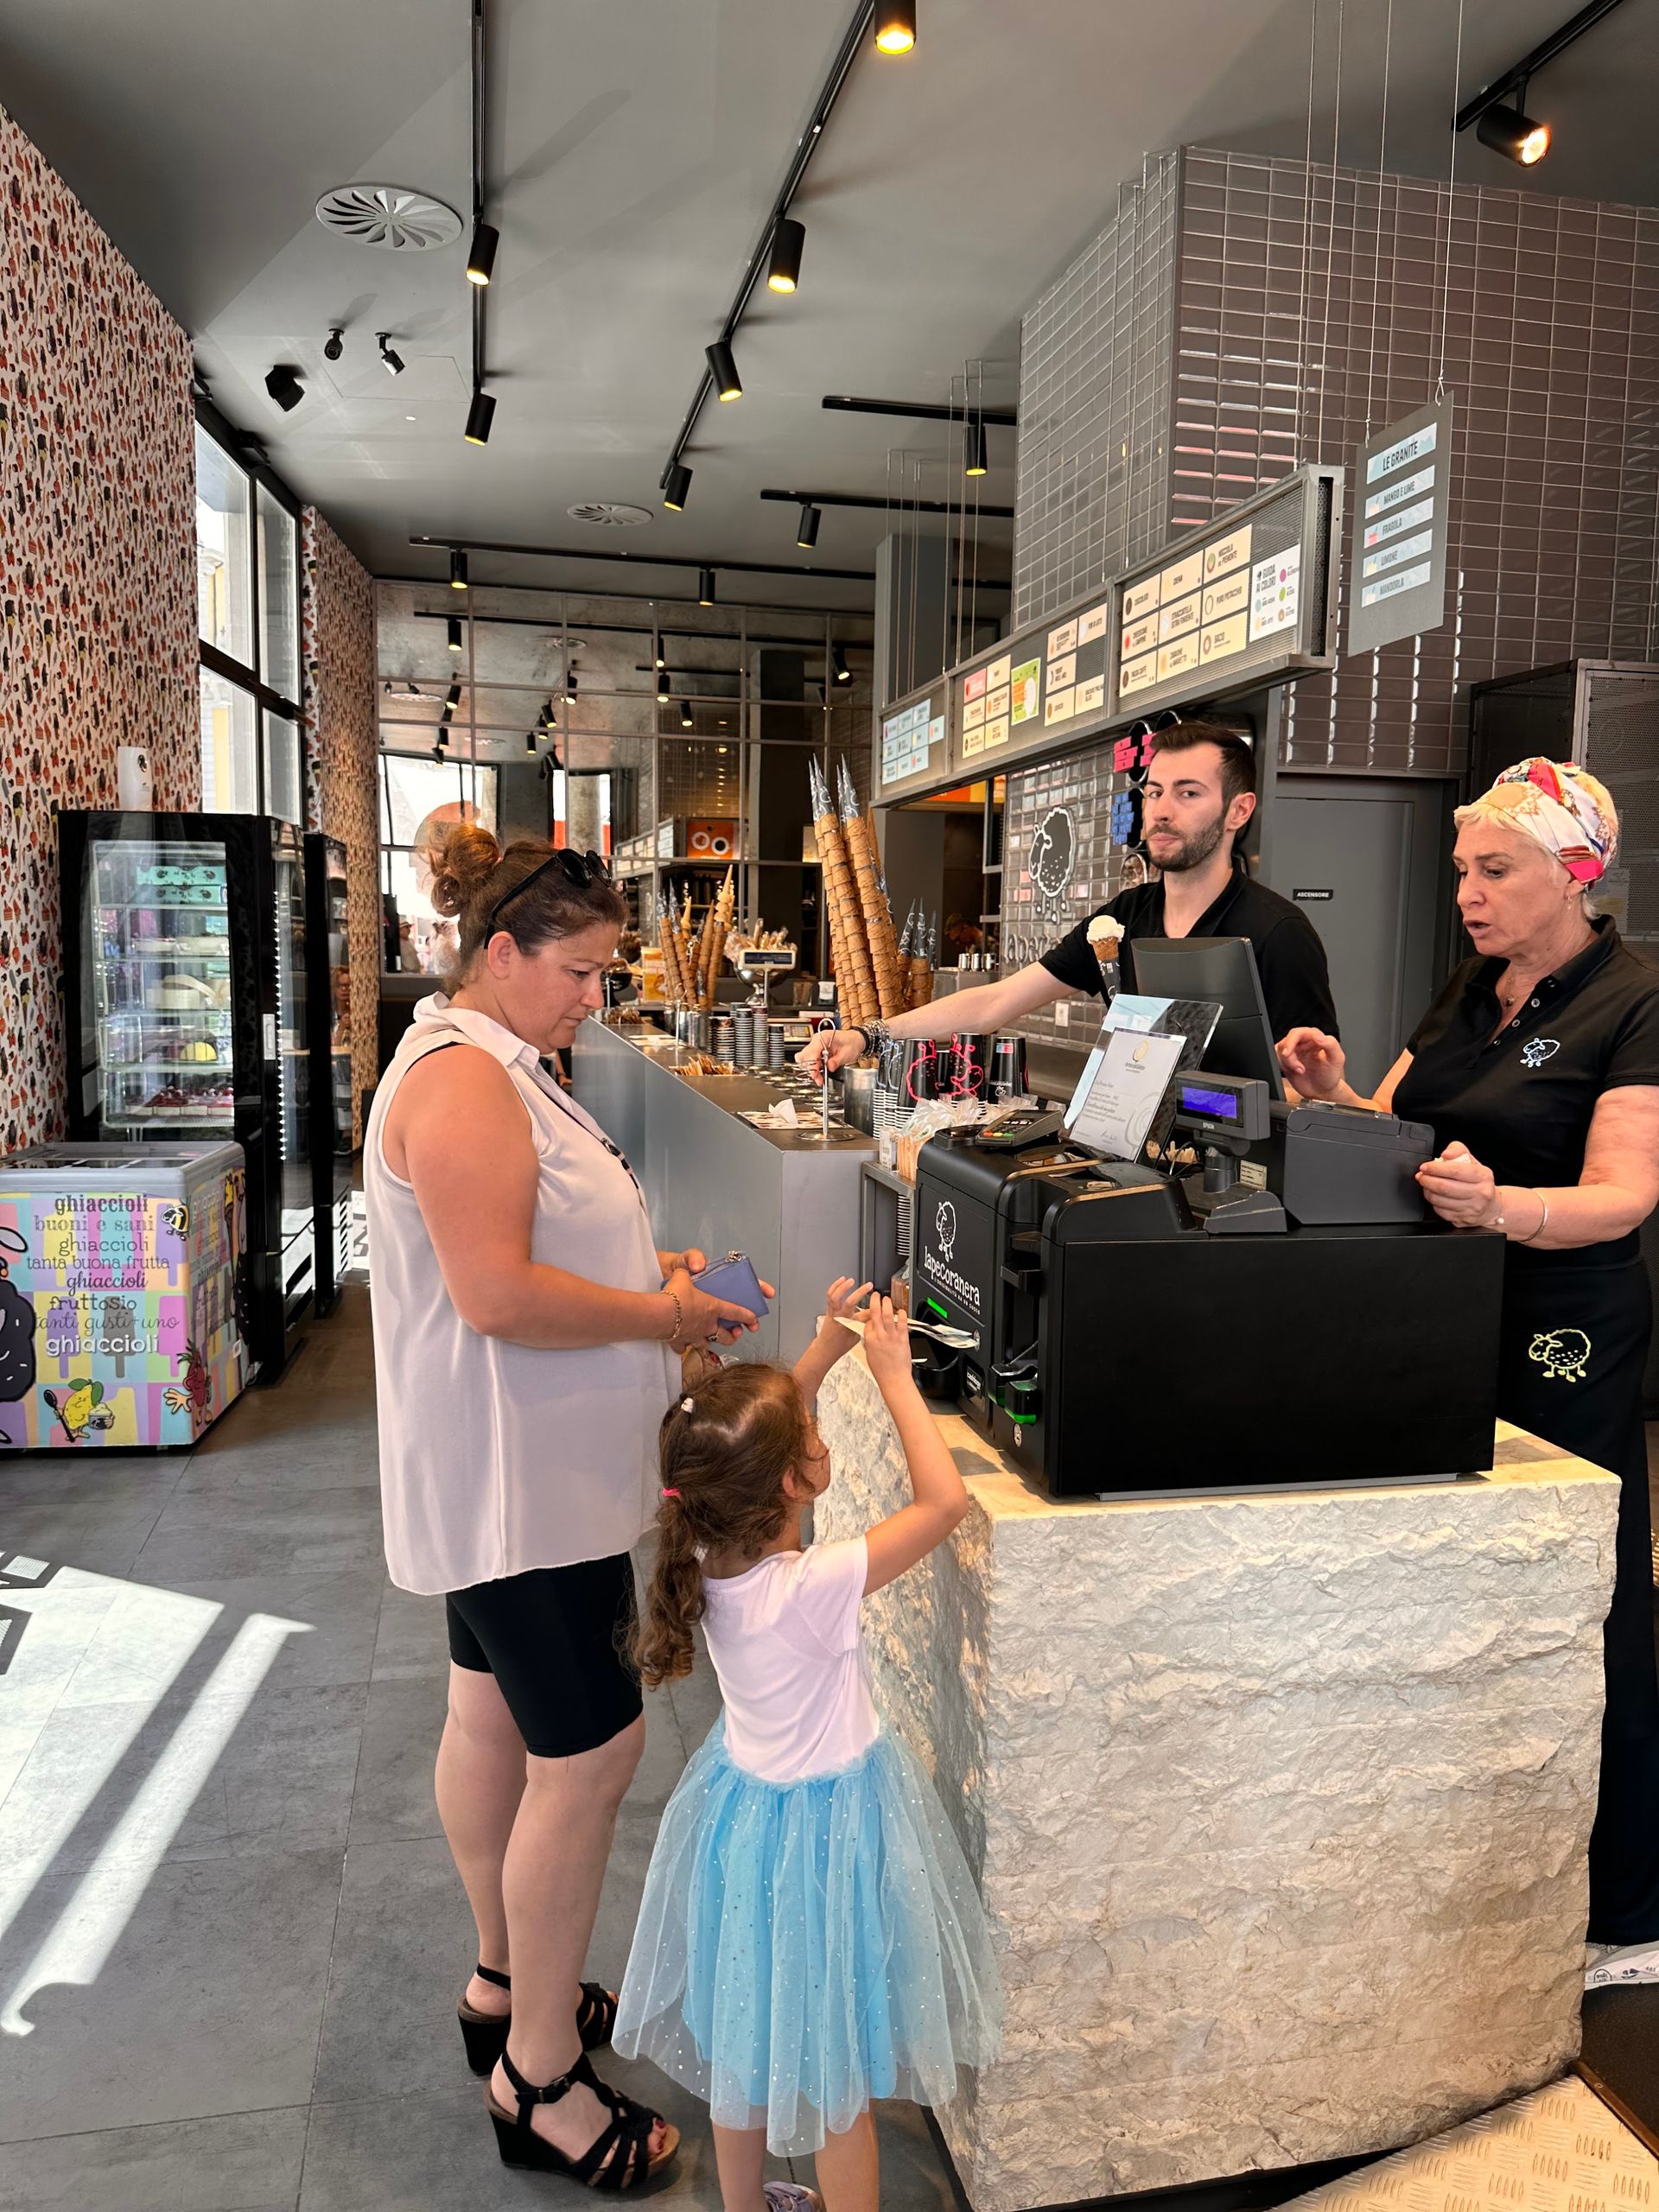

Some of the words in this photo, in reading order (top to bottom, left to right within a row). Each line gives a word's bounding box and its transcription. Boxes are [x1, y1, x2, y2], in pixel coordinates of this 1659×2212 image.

[1382, 455, 1390, 471] LE
[1391, 442, 1418, 467] GRANITE
[1383, 489, 1399, 505] MANGO
[1400, 486, 1403, 496] E
[1404, 480, 1415, 495] LIME
[1382, 518, 1402, 535] FRAGOLA
[1381, 550, 1398, 566] LIMONE
[54, 1194, 149, 1215] ghiaccioli
[35, 1215, 89, 1231] buoni
[97, 1220, 106, 1231] e
[114, 1216, 156, 1231] sani
[59, 1232, 149, 1256] ghiaccioli
[28, 1256, 67, 1269] tanta
[73, 1255, 121, 1269] buona
[126, 1255, 170, 1269] frutta
[67, 1270, 149, 1296] ghiaccioli
[924, 1245, 981, 1306] lapecoranera
[49, 1294, 137, 1311] fruttosio
[46, 1334, 159, 1357] ghiaccioli
